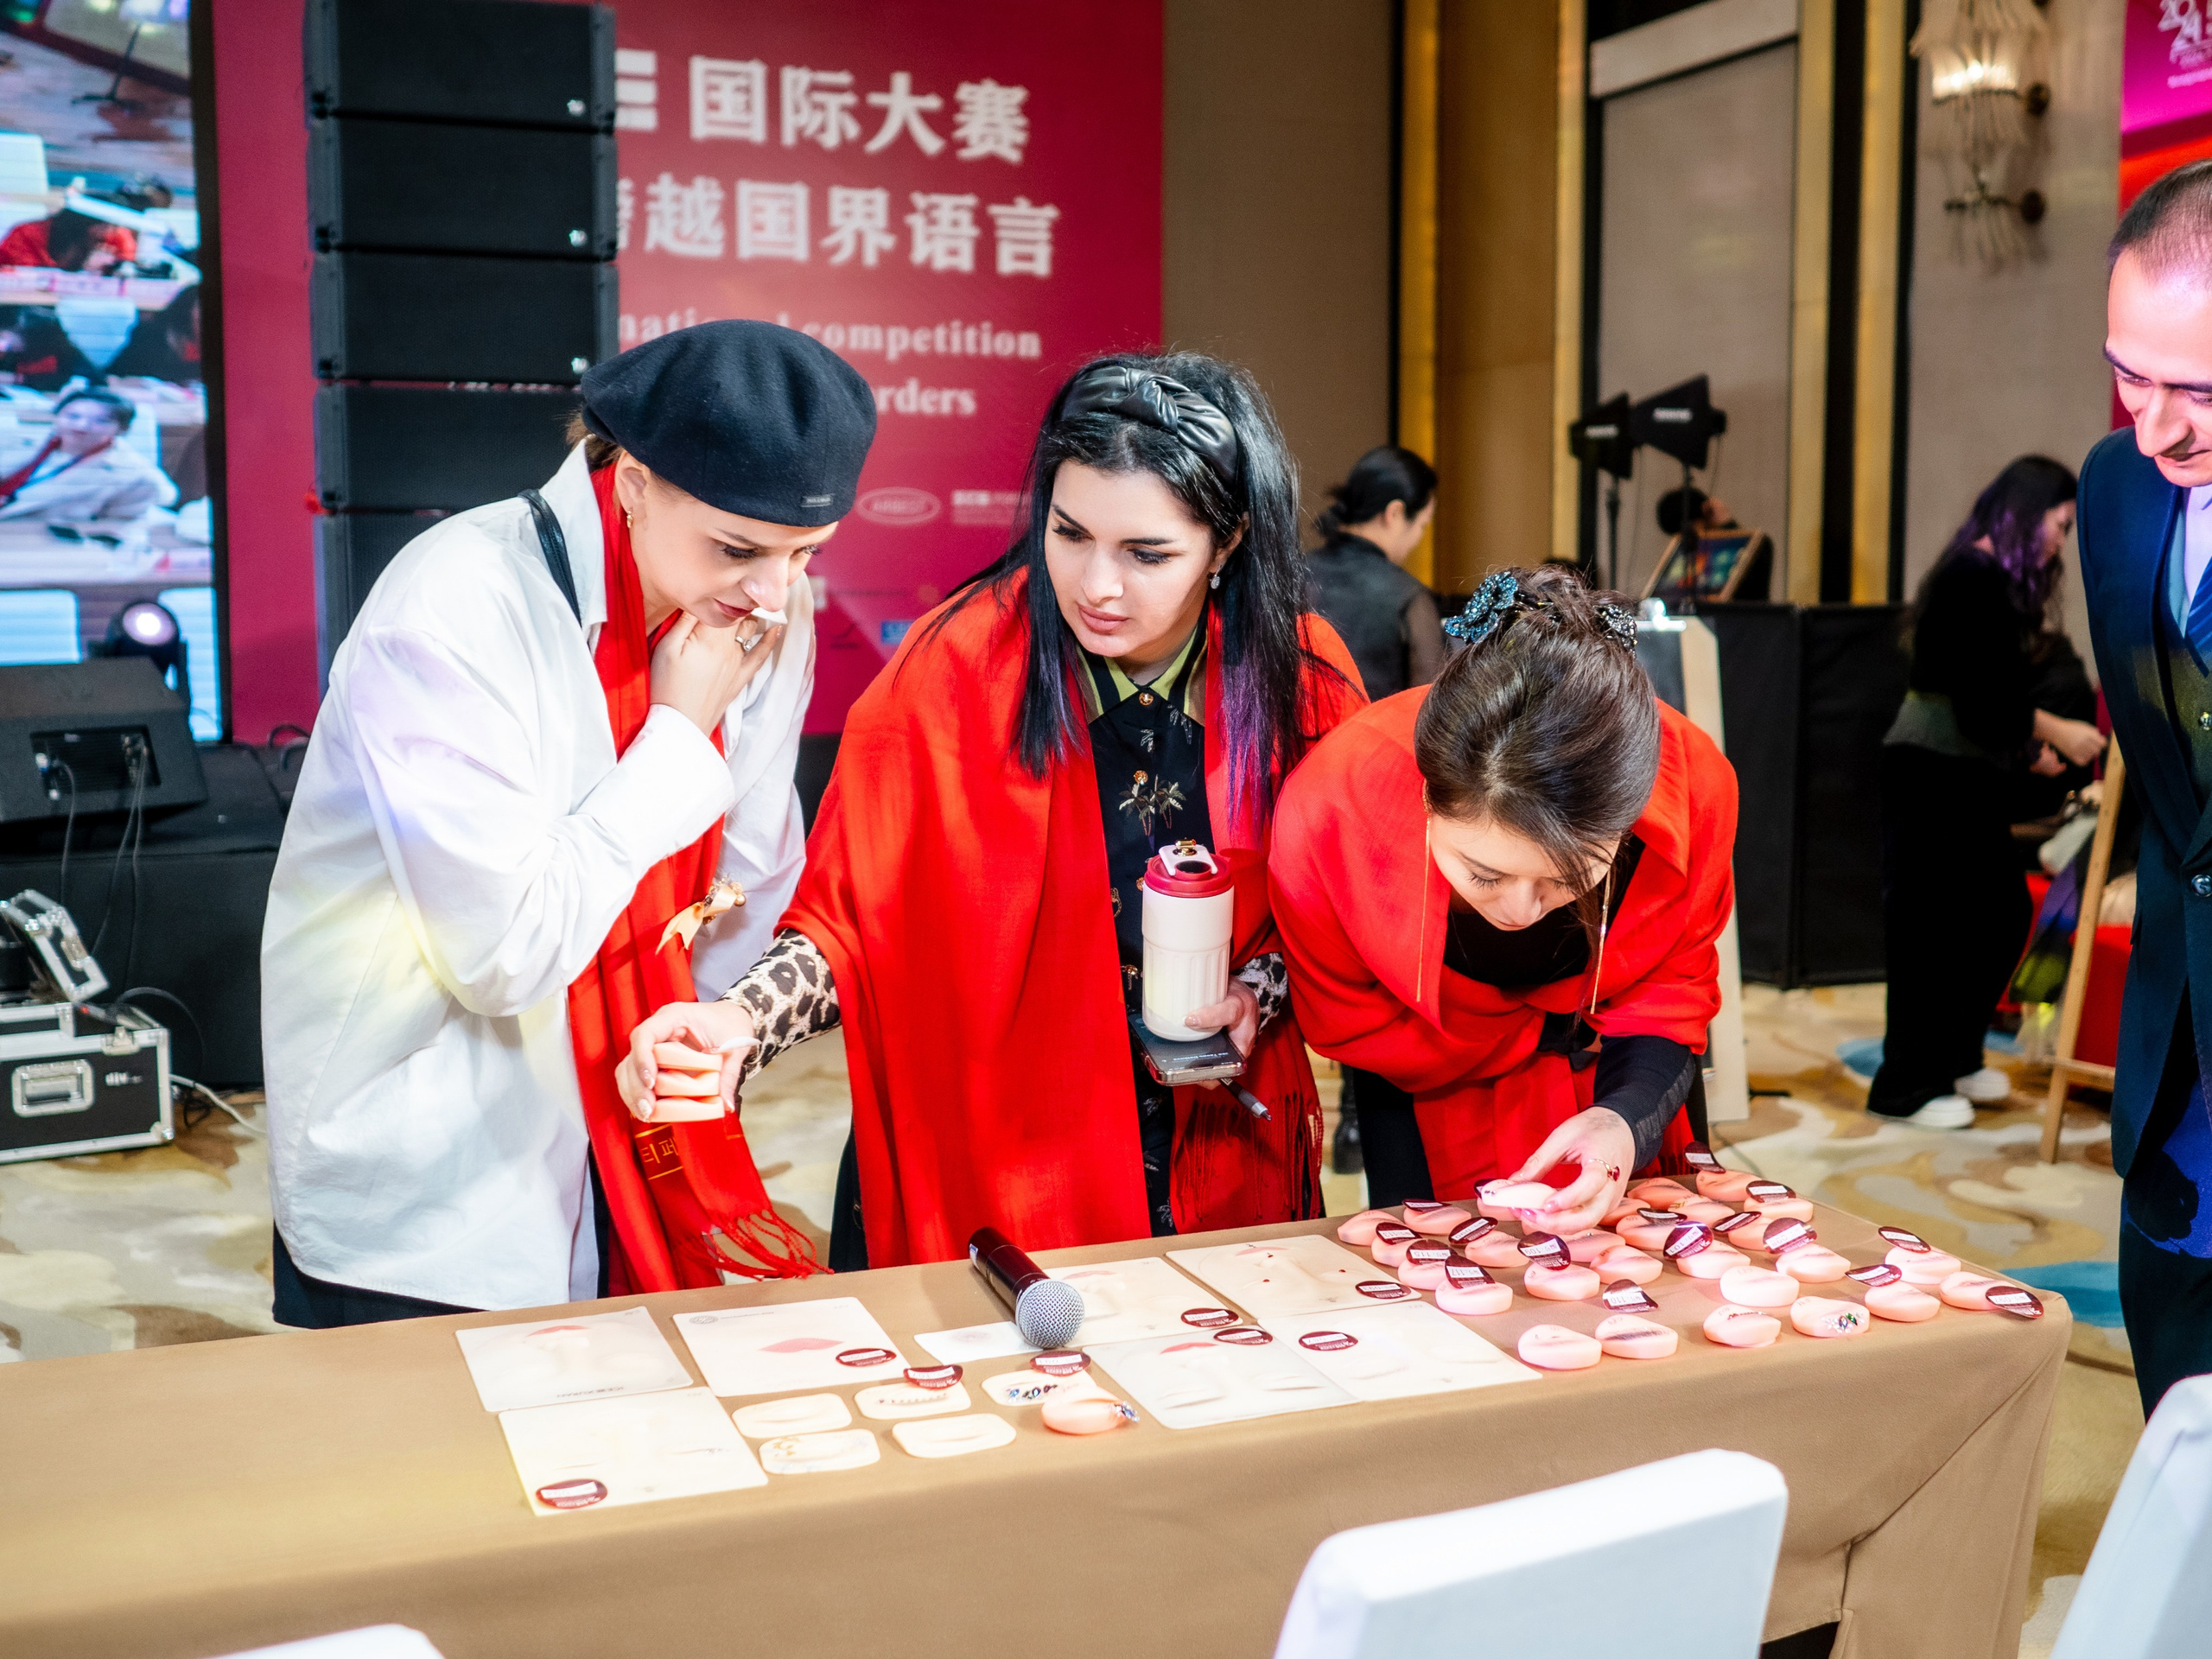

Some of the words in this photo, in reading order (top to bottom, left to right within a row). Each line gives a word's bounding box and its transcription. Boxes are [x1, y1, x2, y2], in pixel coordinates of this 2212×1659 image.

[689, 54, 1029, 164] 国际大赛
[617, 172, 1060, 278] 越国界语言
[800, 316, 1042, 361] competition
[874, 377, 977, 416] rders
